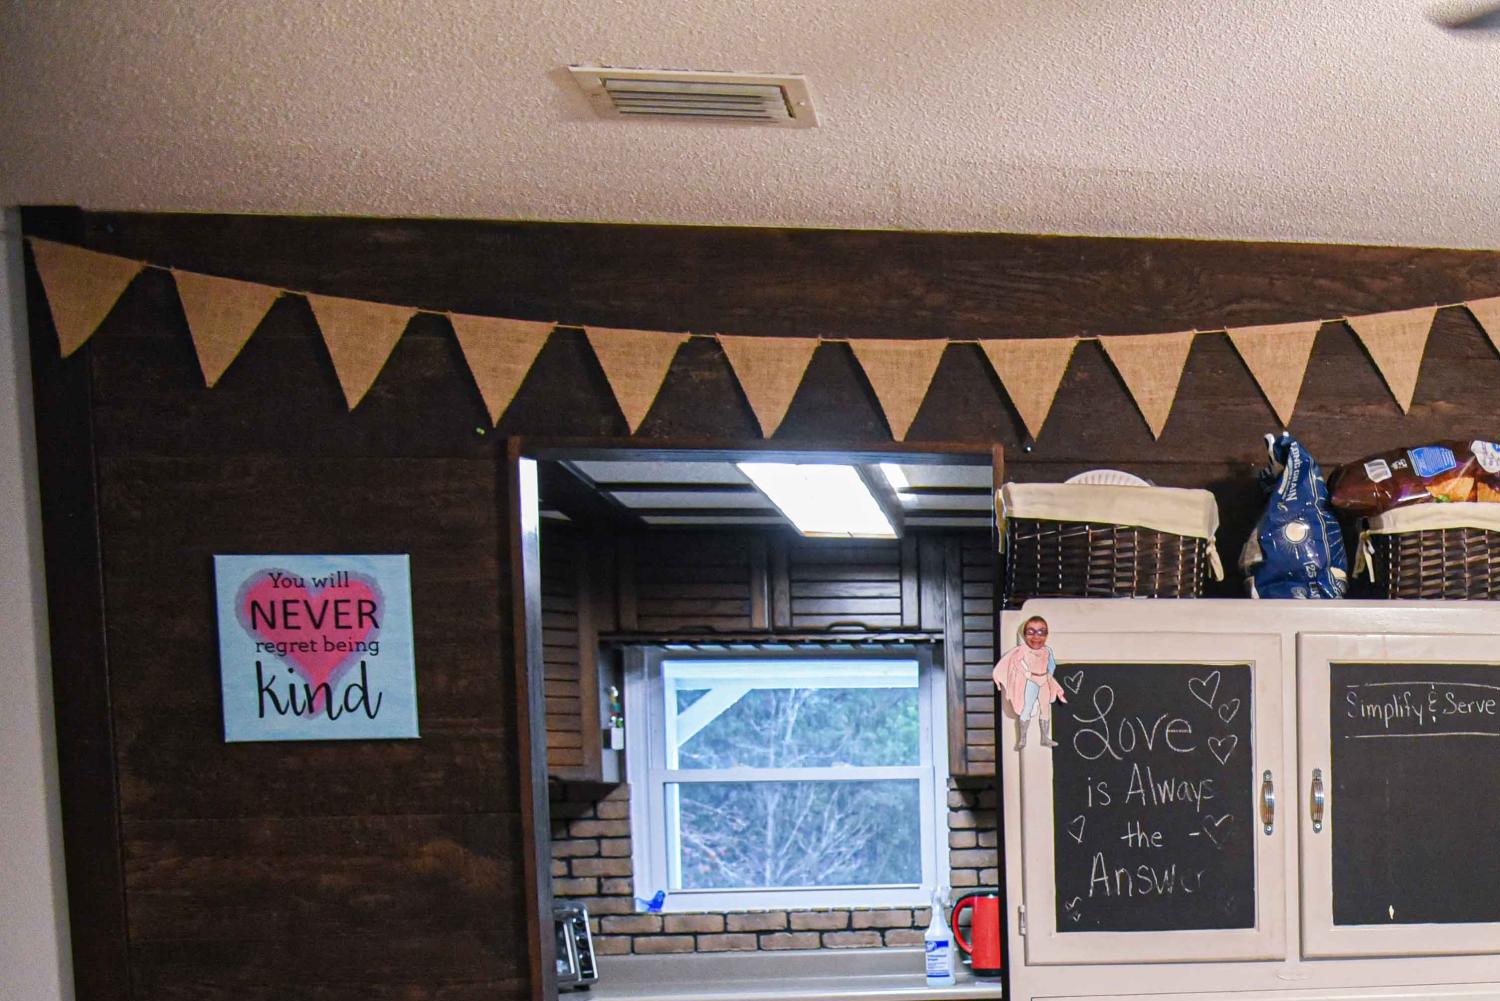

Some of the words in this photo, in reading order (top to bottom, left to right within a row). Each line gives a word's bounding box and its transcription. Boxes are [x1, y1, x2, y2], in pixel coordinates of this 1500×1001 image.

[1286, 469, 1299, 502] GRAIN
[269, 572, 305, 589] You
[311, 570, 350, 589] will
[250, 599, 381, 631] NEVER
[255, 638, 318, 657] regret
[323, 635, 381, 656] being
[255, 660, 383, 721] kind
[1072, 684, 1197, 761] Love
[1346, 690, 1424, 729] Simplify
[1442, 691, 1497, 716] Serve
[1087, 776, 1112, 808] is
[1125, 762, 1216, 813] Always
[1120, 820, 1164, 849] the
